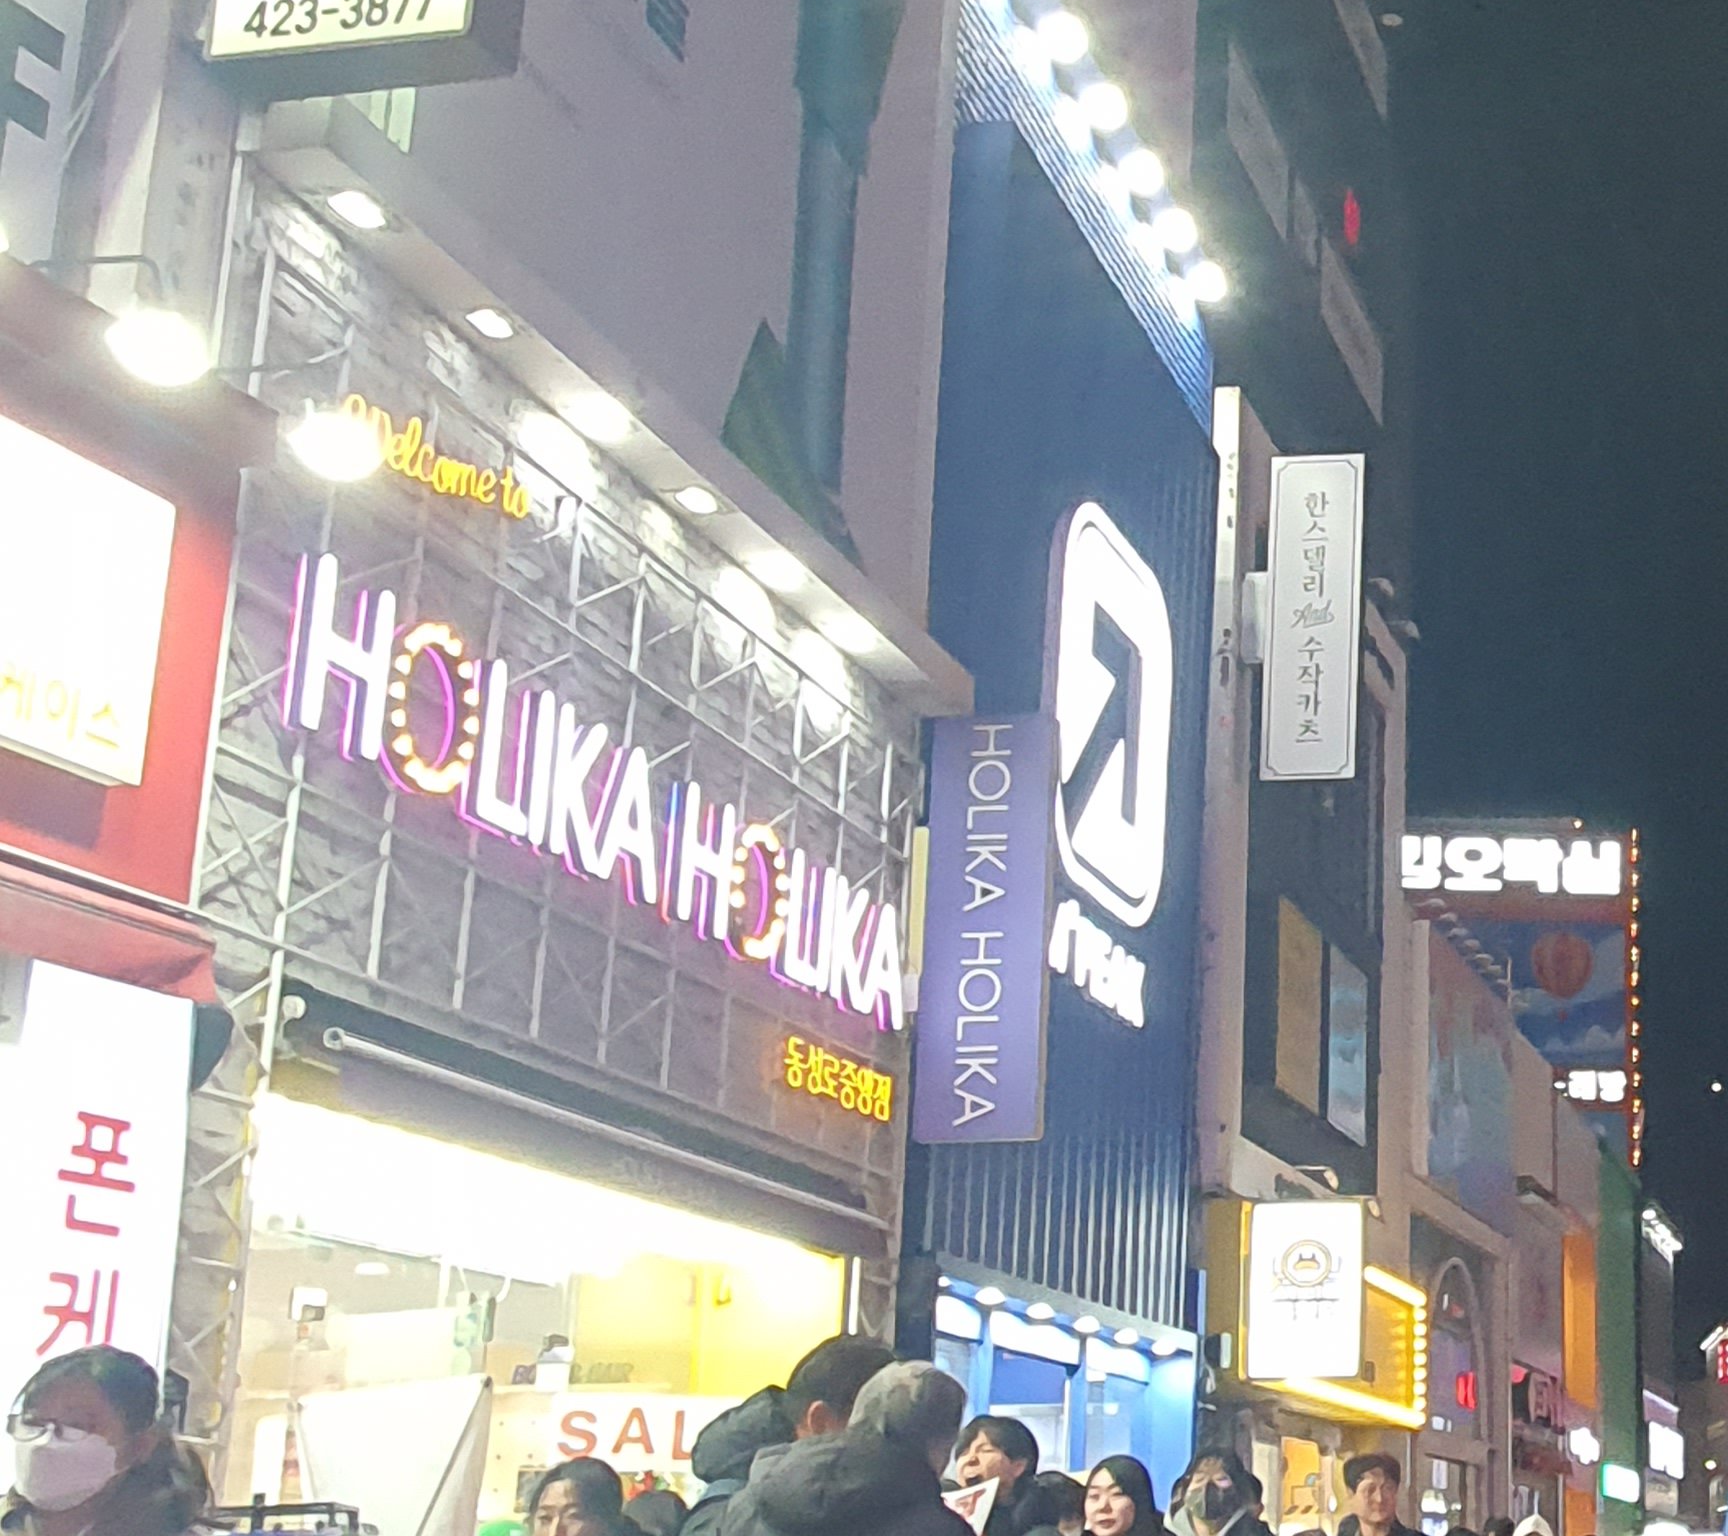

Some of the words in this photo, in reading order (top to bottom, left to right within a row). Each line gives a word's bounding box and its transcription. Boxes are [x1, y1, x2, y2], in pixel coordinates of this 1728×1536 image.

[500, 465, 530, 520] to
[1302, 492, 1329, 598] 한스델리
[284, 552, 657, 906] HOLIKA
[662, 780, 903, 1031] HOLIKA
[963, 722, 1013, 913] HOLIKA
[952, 931, 1003, 1128] HOLIKA
[558, 1406, 692, 1461] SAL
